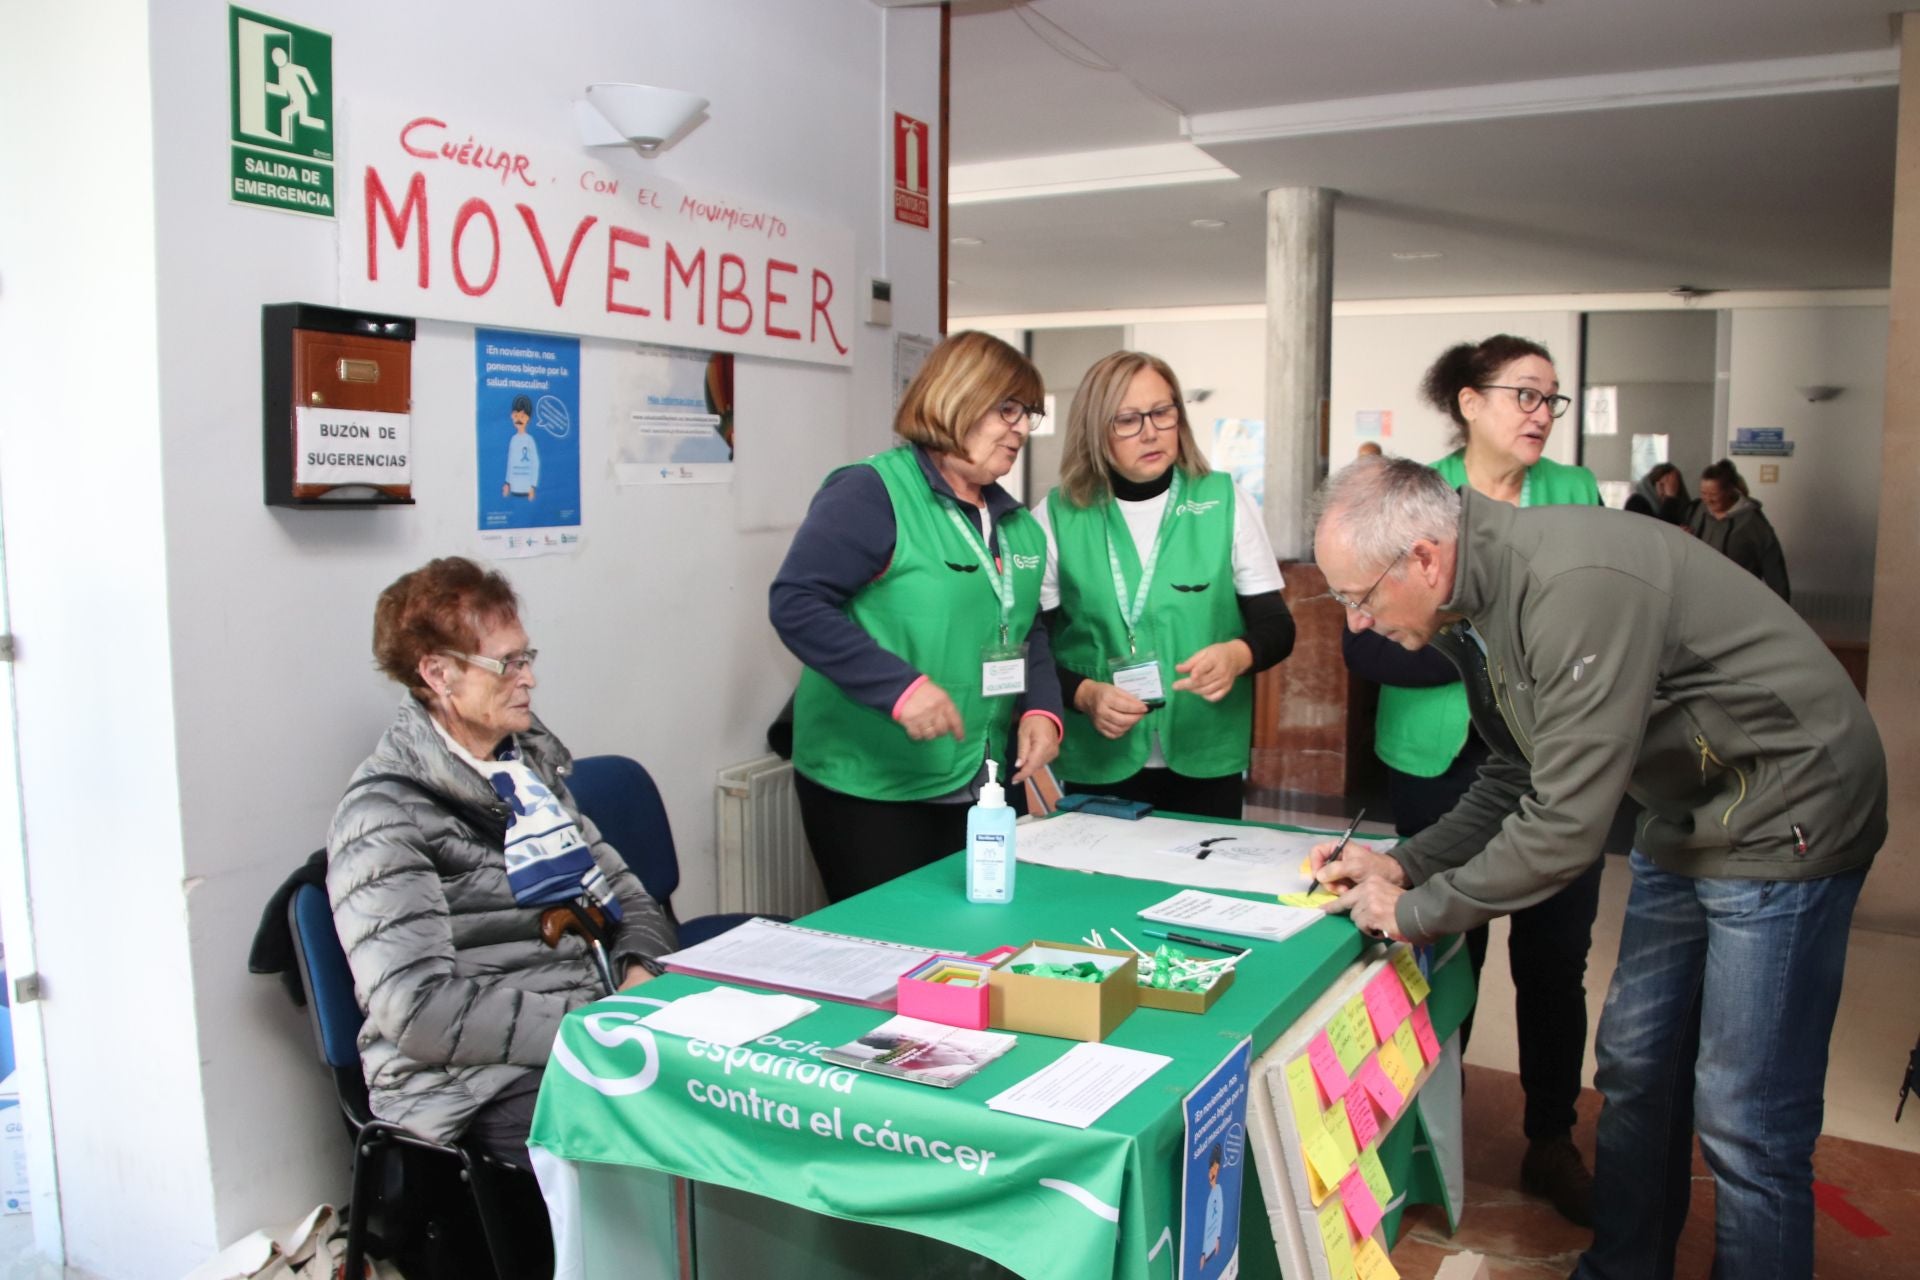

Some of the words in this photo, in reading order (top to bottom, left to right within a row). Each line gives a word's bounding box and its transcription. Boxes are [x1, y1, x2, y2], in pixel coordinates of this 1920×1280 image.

[245, 157, 298, 180] SALIDA
[301, 168, 320, 185] DE
[234, 177, 331, 208] EMERGENCIA
[580, 170, 619, 195] CON
[637, 188, 662, 209] EL
[679, 195, 788, 238] MOVIMIENTO
[364, 165, 849, 355] MOVEMBER
[499, 347, 541, 359] noviembre,
[542, 351, 556, 360] nos
[486, 362, 521, 373] ponemos
[523, 363, 546, 376] bigote
[547, 368, 560, 376] por
[486, 378, 508, 387] salud
[320, 422, 370, 438] BUZÓN
[379, 427, 396, 439] DE
[307, 452, 406, 467] SUGERENCIAS
[686, 1038, 859, 1094] española
[687, 1078, 801, 1130] contra
[809, 1107, 844, 1140] el
[852, 1119, 997, 1176] cáncer
